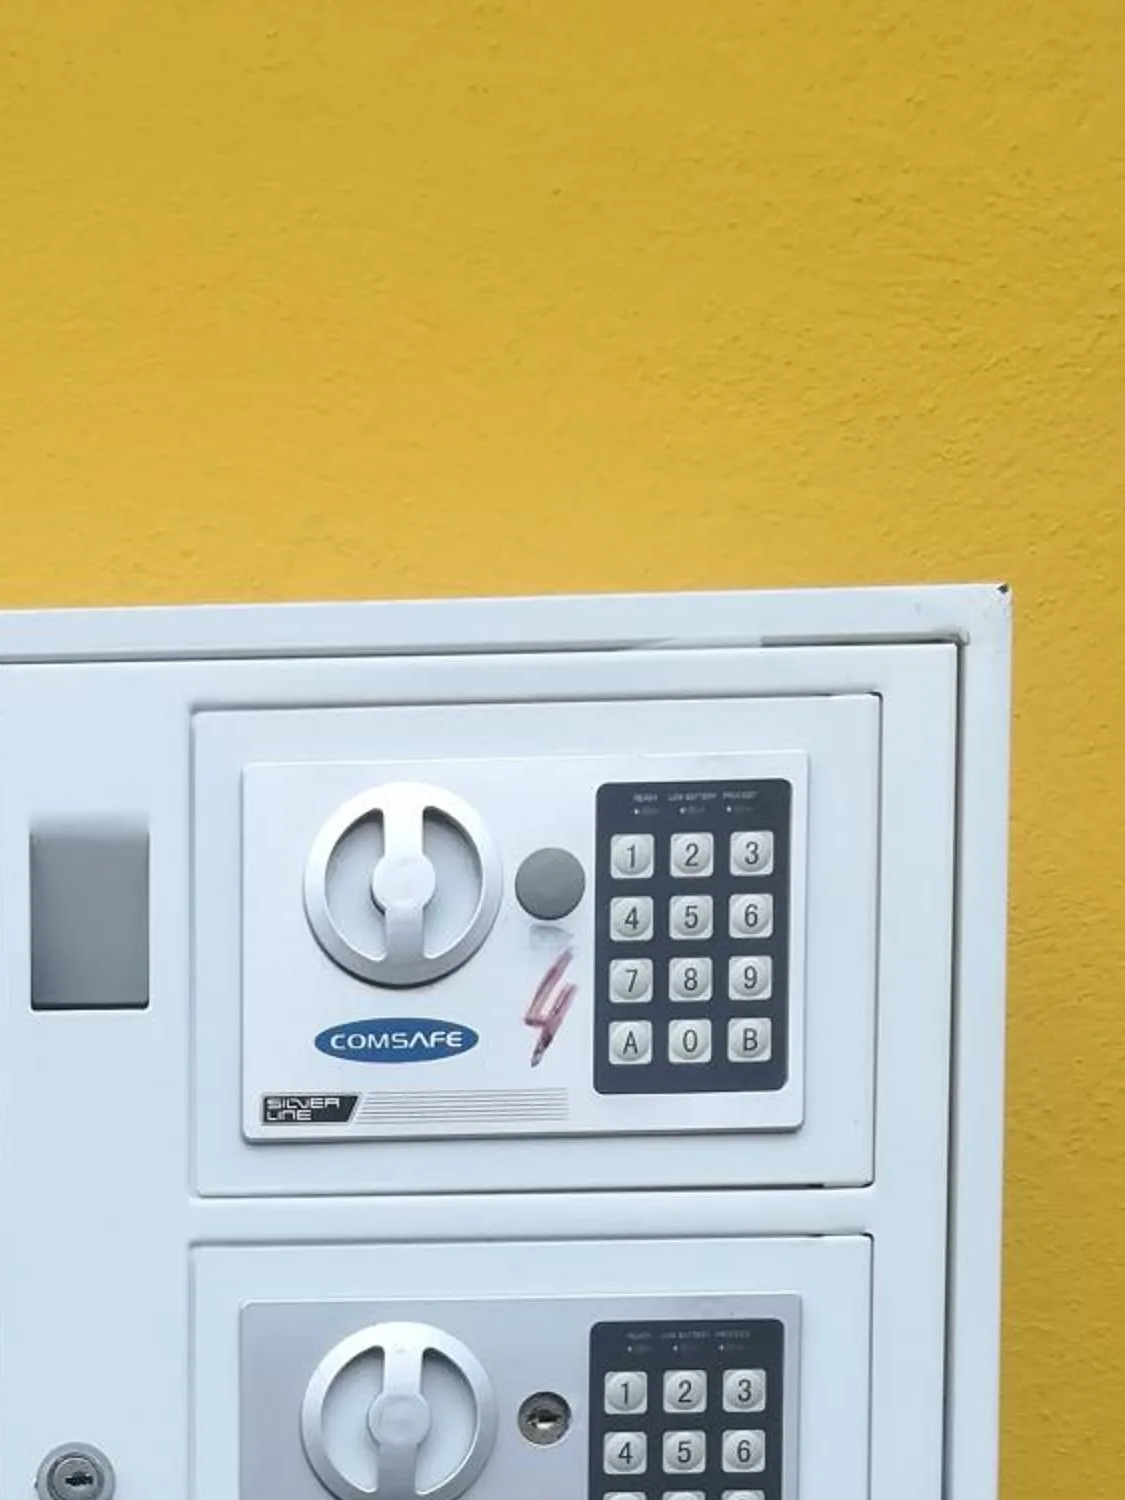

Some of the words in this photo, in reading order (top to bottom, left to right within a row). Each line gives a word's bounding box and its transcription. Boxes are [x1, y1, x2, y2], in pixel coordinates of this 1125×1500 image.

[685, 844, 699, 866] 2
[745, 842, 759, 864] 3
[625, 907, 639, 929] 4
[685, 906, 698, 928] 5
[745, 904, 758, 927] 6
[625, 970, 638, 992] 7
[684, 968, 698, 990] 8
[744, 967, 757, 989] 9
[524, 950, 577, 1068] 4
[330, 1031, 463, 1050] COMSAFE
[623, 1031, 638, 1054] A
[683, 1030, 697, 1052] 0
[743, 1028, 757, 1050] B
[266, 1098, 339, 1109] SILVER
[678, 1381, 692, 1403] 2
[738, 1380, 751, 1402] 3
[619, 1442, 632, 1464] 4
[678, 1442, 691, 1463] 5
[737, 1440, 751, 1462] 6
